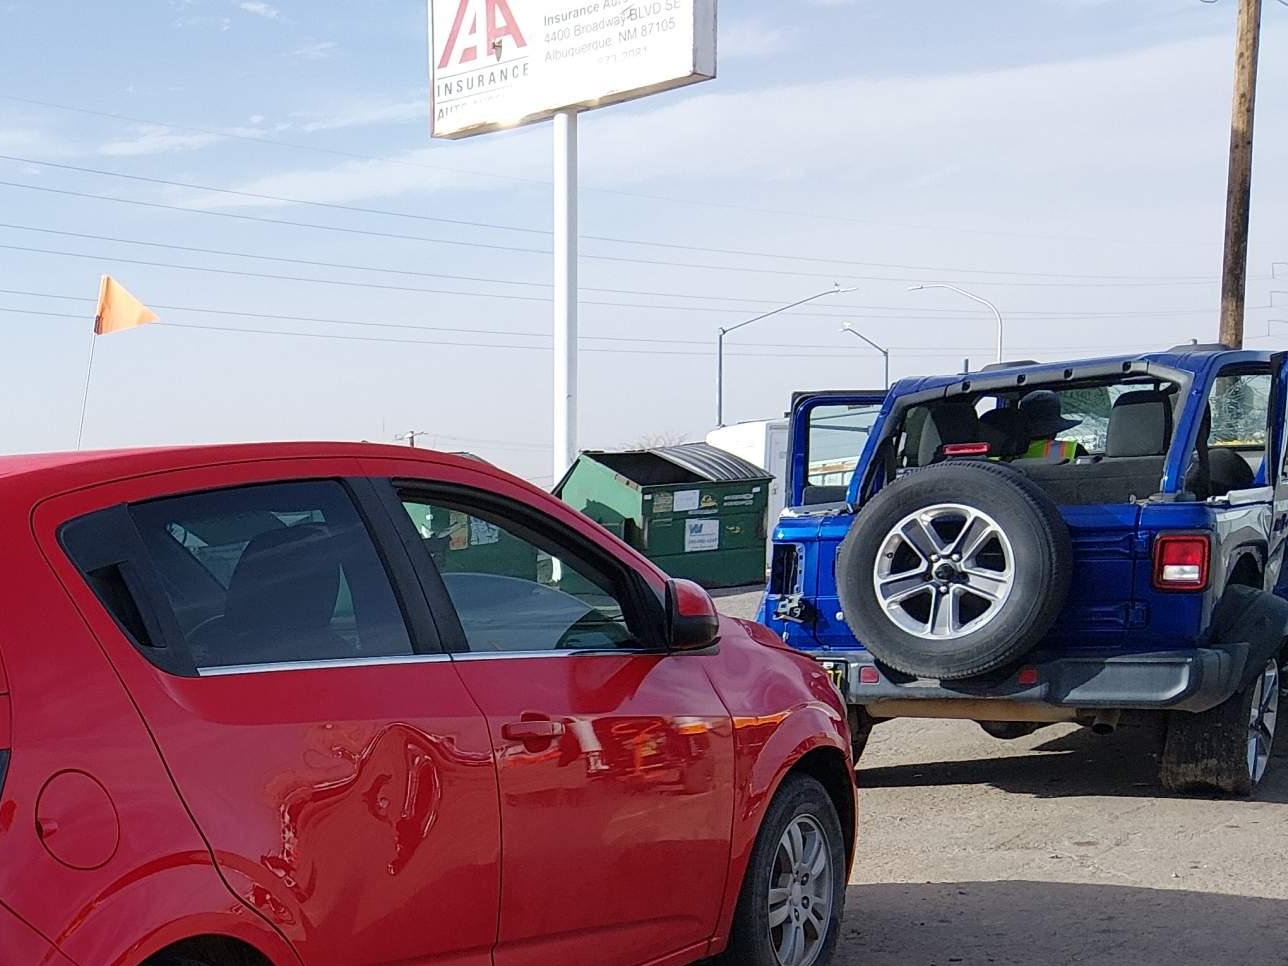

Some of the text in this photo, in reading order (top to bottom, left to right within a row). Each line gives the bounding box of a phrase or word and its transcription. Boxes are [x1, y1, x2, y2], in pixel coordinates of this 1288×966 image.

[543, 3, 599, 26] Insurance
[544, 27, 570, 42] 4400
[573, 16, 626, 37] Broadway
[629, 2, 662, 21] BLVD
[619, 27, 637, 42] NM
[641, 16, 675, 37] 87105
[437, 62, 529, 97] INSURANCE
